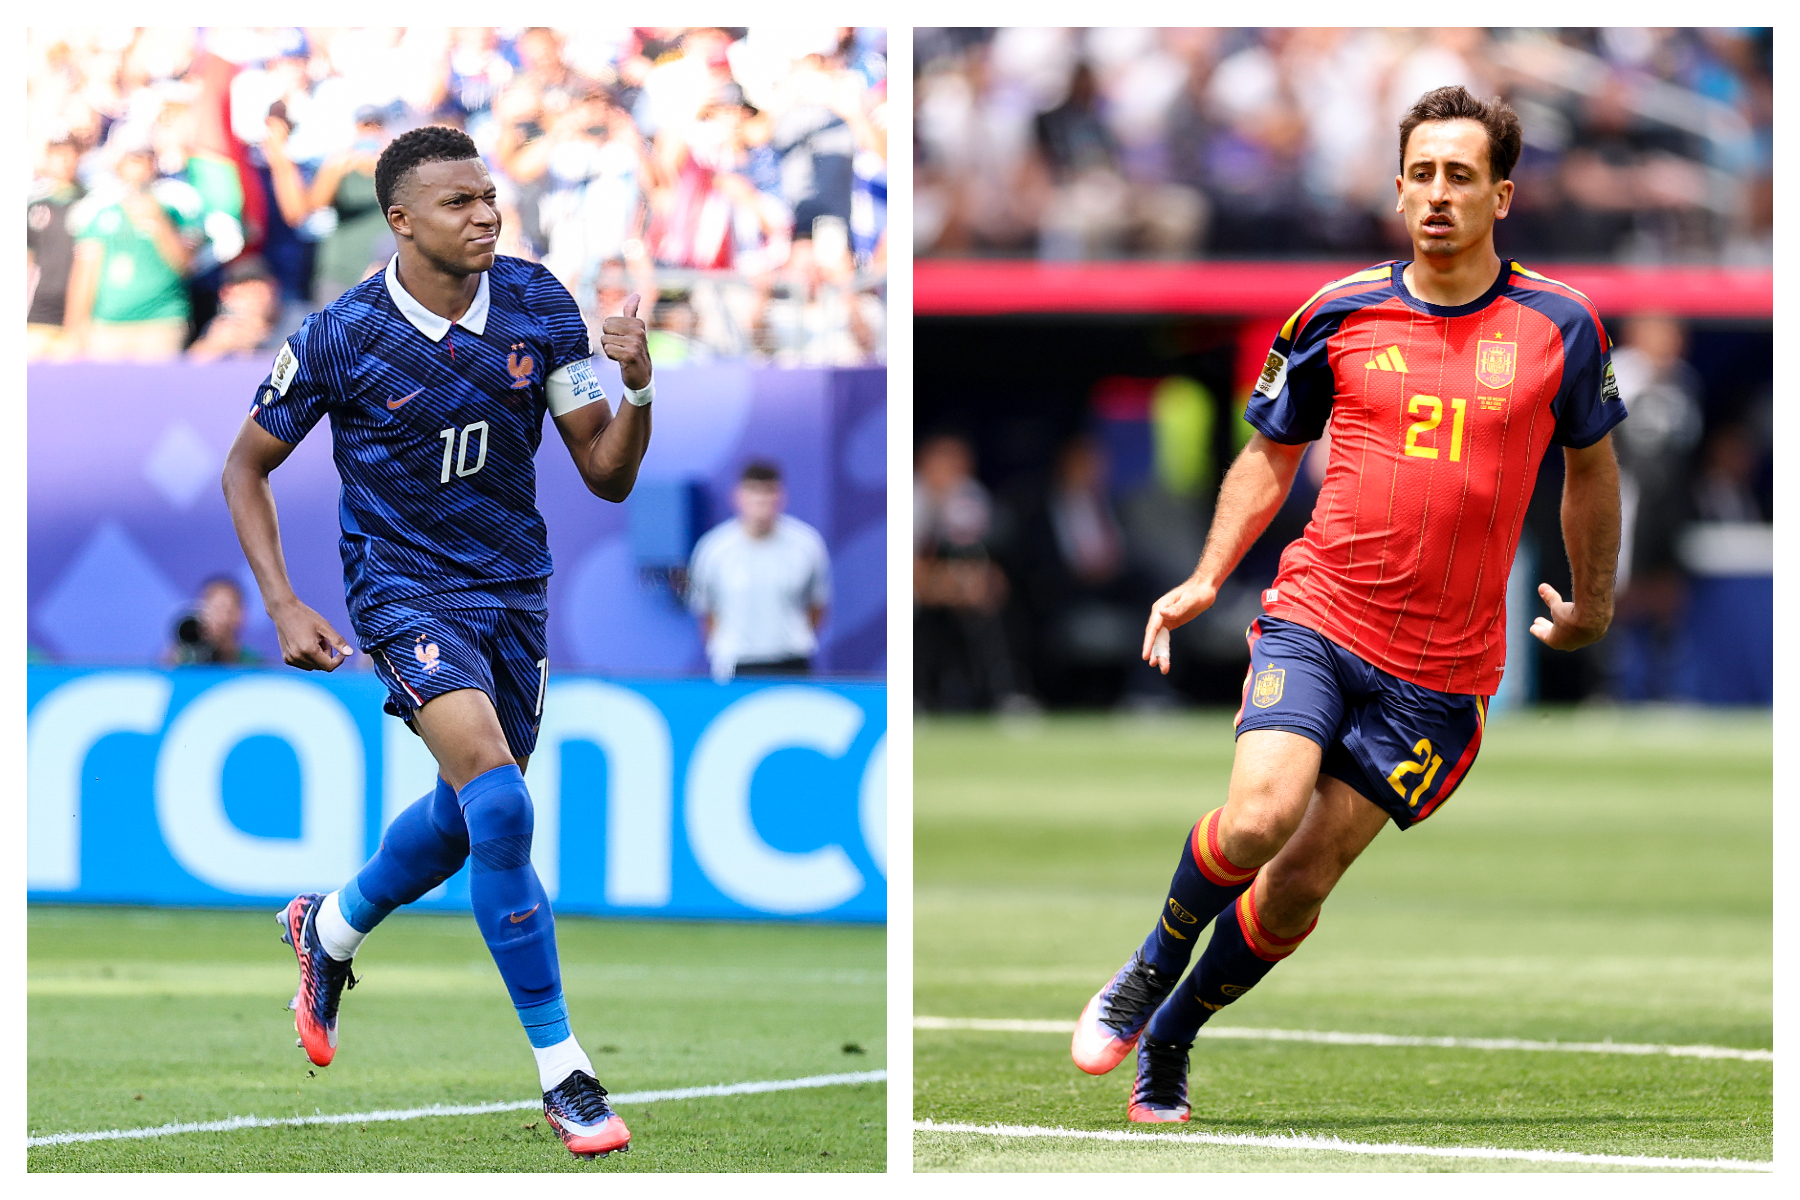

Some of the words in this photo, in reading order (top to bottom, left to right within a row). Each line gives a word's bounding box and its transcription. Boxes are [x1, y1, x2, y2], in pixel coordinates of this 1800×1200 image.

[571, 385, 588, 396] the
[439, 420, 489, 484] 10
[1404, 394, 1467, 462] 21
[535, 657, 549, 717] 1
[27, 672, 887, 914] ramc
[1386, 738, 1444, 808] 21
